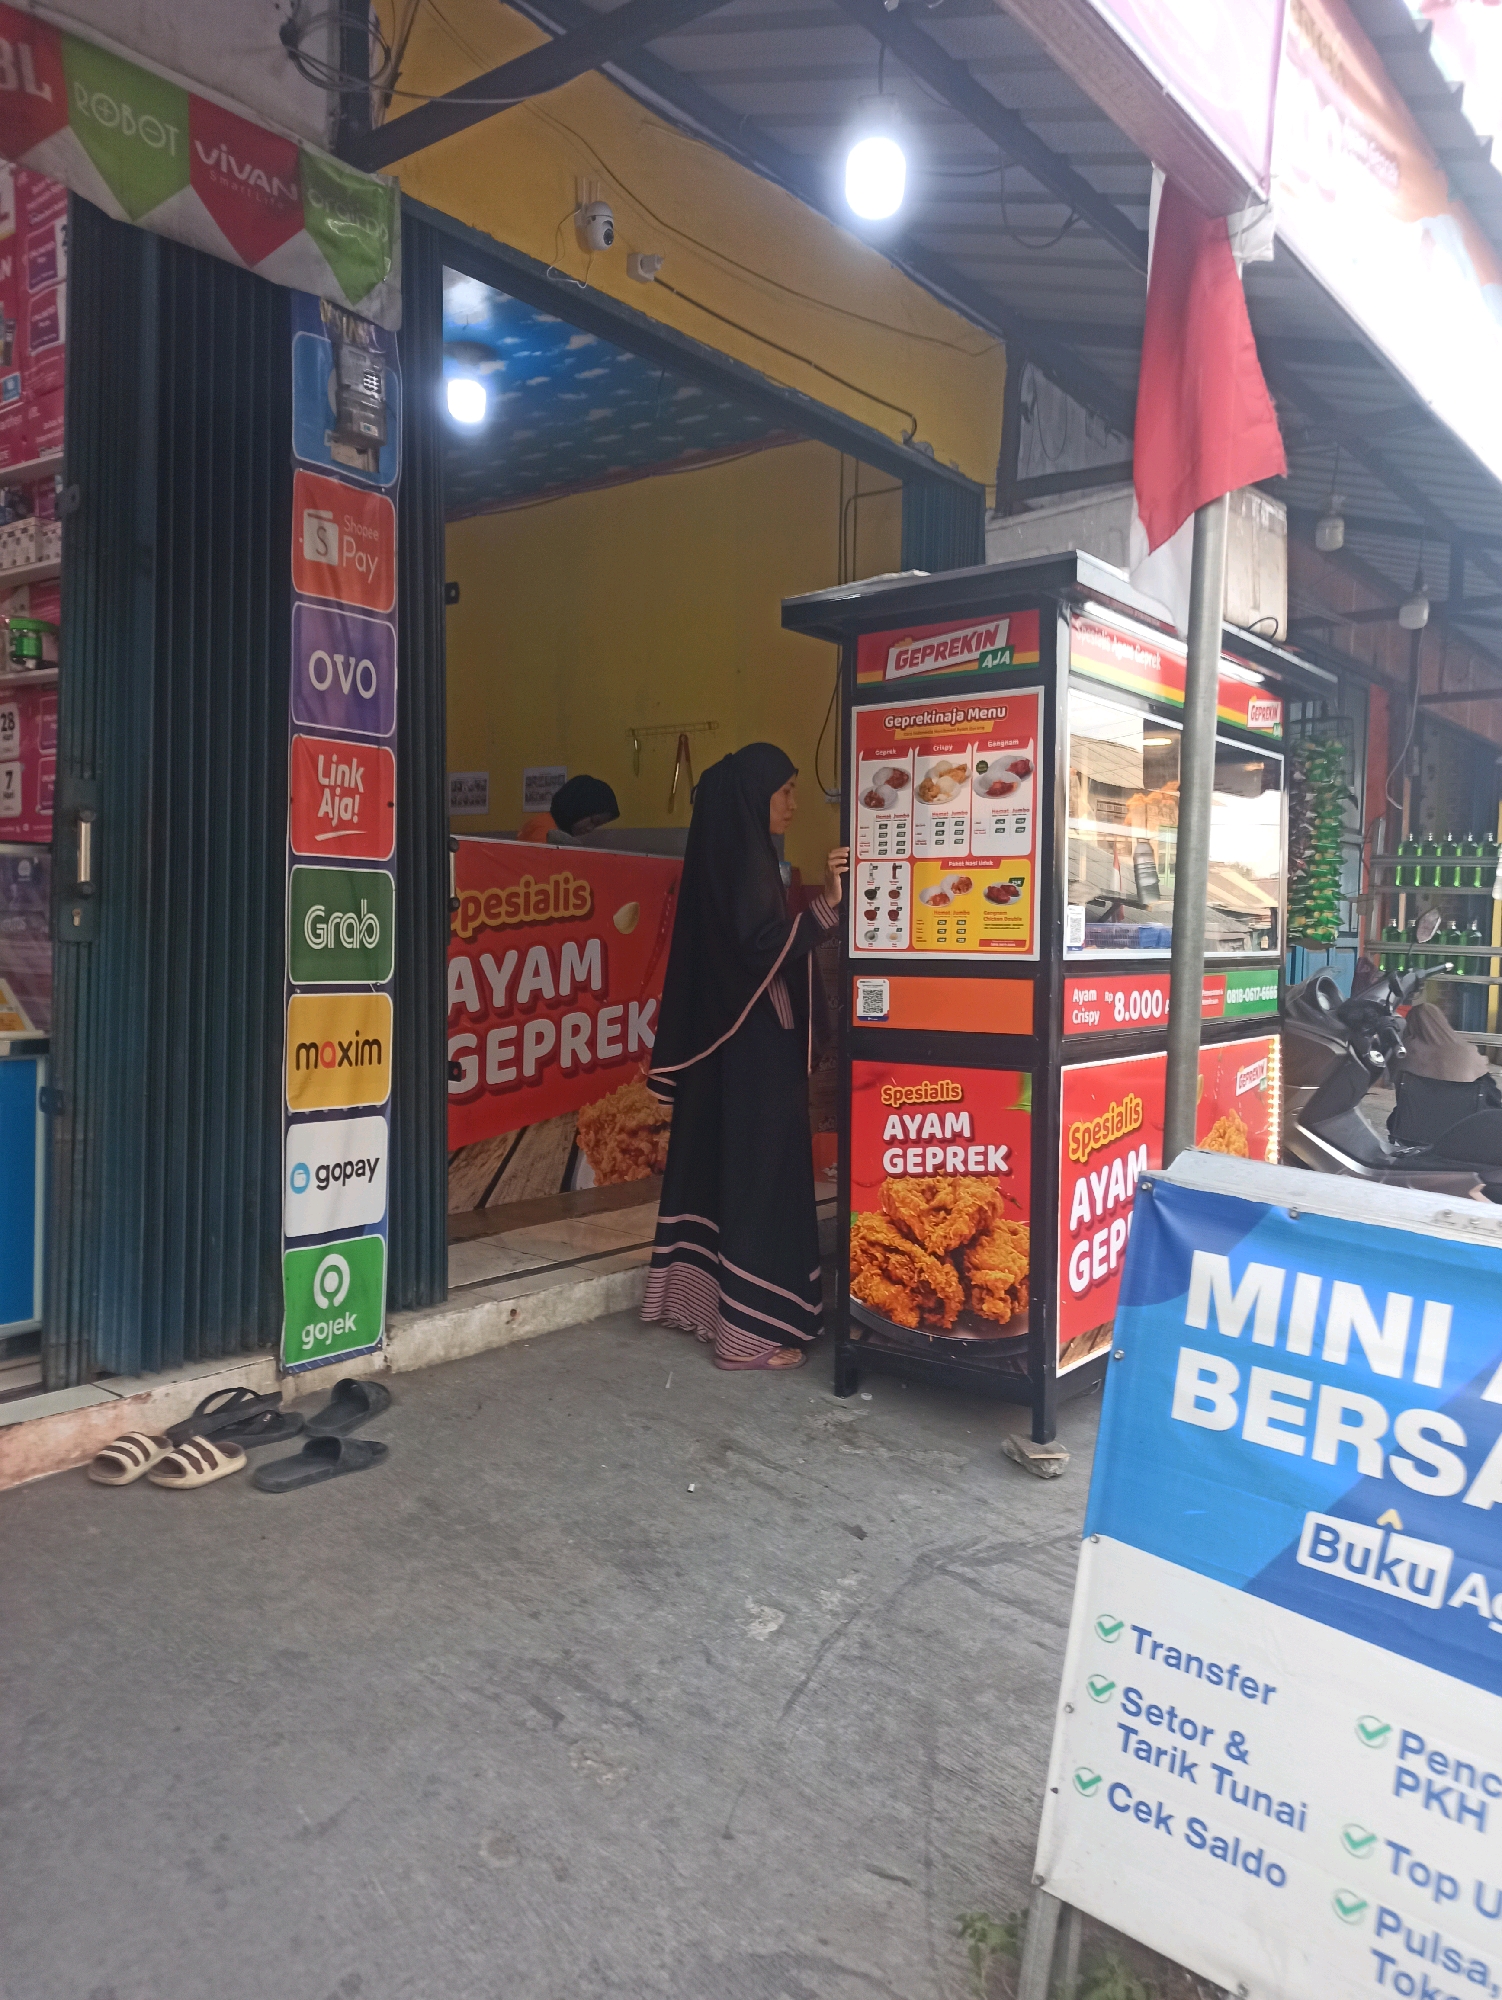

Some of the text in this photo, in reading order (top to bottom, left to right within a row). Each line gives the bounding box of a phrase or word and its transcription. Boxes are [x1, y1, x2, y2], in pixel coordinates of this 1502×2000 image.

[74, 82, 180, 156] ROBOT
[344, 515, 379, 542] Shopee
[343, 535, 379, 584] Pay
[895, 624, 1000, 671] GEPREKIN
[982, 650, 1011, 669] AJA
[309, 650, 376, 699] OVO
[884, 706, 1006, 729] Geprekinaja Menu
[318, 754, 364, 793] Link
[318, 788, 360, 827] Aja!
[304, 899, 380, 950] Grab
[452, 872, 590, 936] pesialis
[448, 938, 602, 1015] AYAM
[1072, 988, 1097, 1005] Ayam
[1072, 1007, 1100, 1026] Crispy
[1104, 991, 1113, 1005] Rp
[1113, 989, 1163, 1022] 8.000
[295, 1030, 383, 1070] maxim
[448, 998, 657, 1094] GEPREK
[882, 1080, 962, 1107] Spesialis
[883, 1112, 971, 1141] AYAM
[1070, 1094, 1142, 1160] Spesialis
[315, 1156, 380, 1191] gopay
[883, 1145, 1009, 1174] GEPREK
[1069, 1143, 1148, 1231] AYAM
[1069, 1210, 1134, 1293] GEP
[302, 1312, 357, 1350] gojek
[1184, 1249, 1454, 1389] MINI
[1130, 1624, 1277, 1705] Transfer
[1120, 1686, 1250, 1764] Setor &
[1116, 1723, 1307, 1832] Tarik Tunai
[1393, 1765, 1487, 1833] PKH
[1107, 1781, 1287, 1889] Cek Saldo
[1385, 1839, 1460, 1904] Top
[1370, 1948, 1462, 2000] Tok
[1374, 1904, 1501, 1999] Pulsa,
